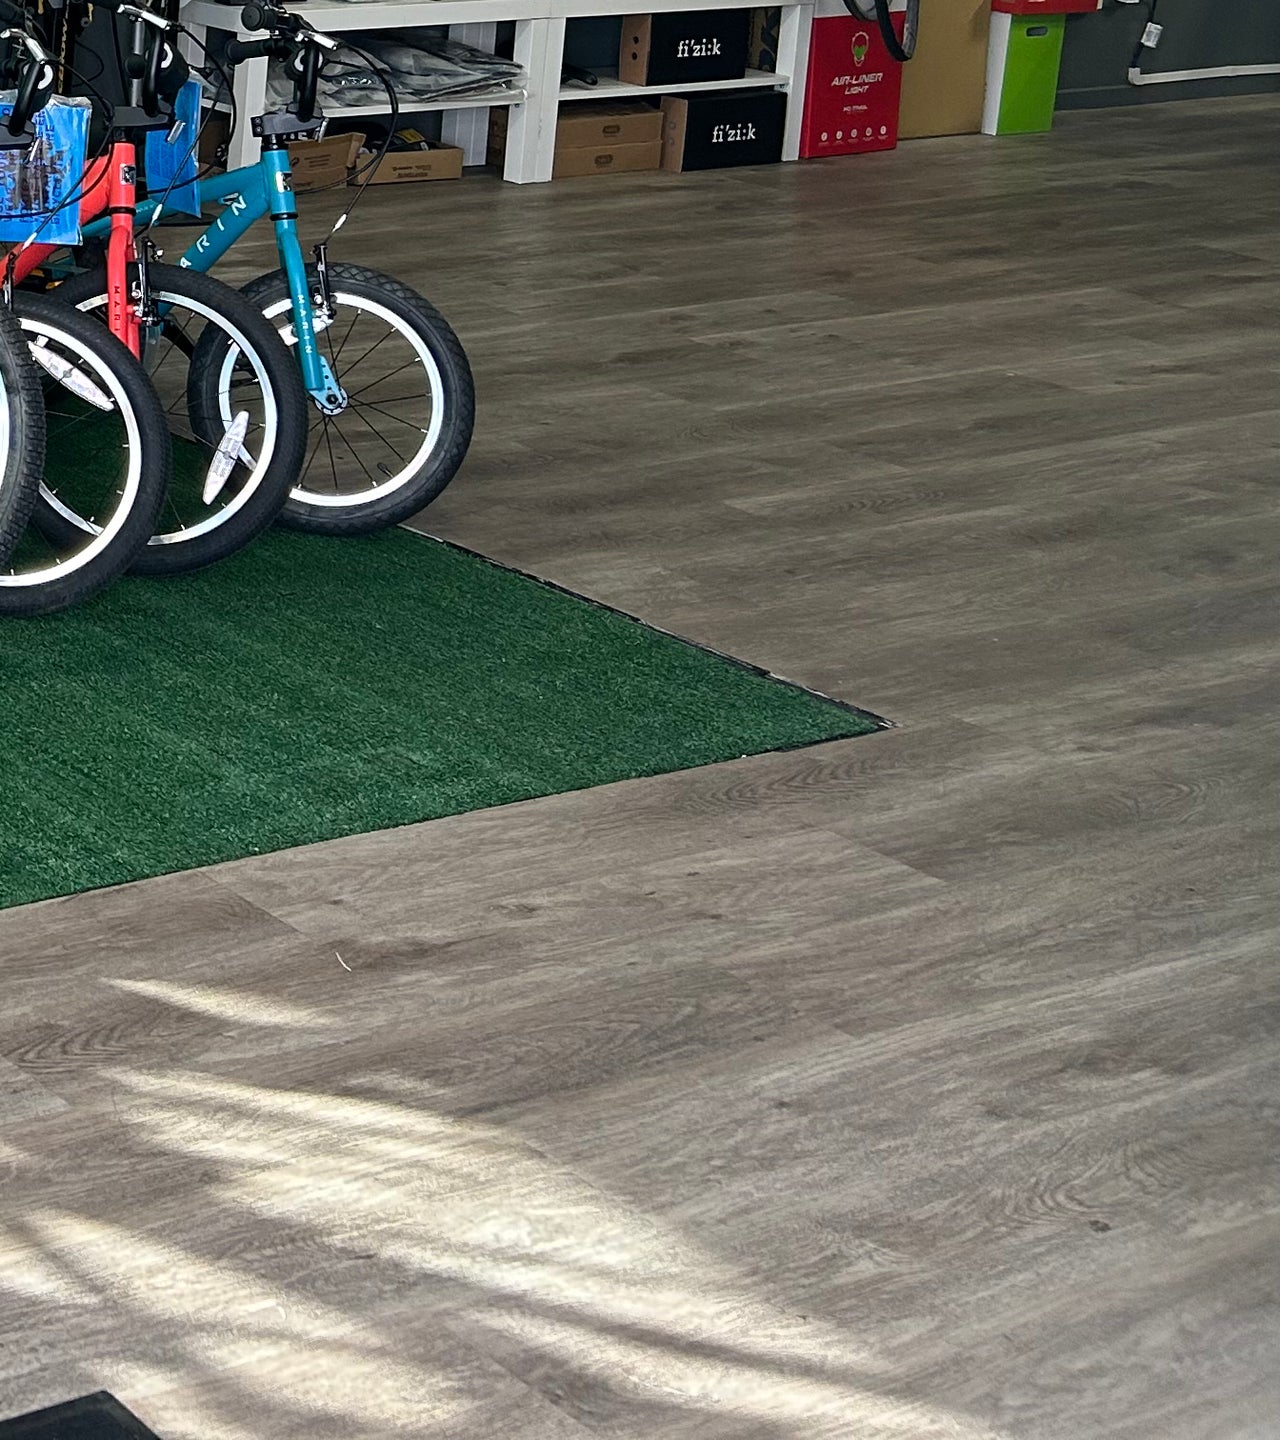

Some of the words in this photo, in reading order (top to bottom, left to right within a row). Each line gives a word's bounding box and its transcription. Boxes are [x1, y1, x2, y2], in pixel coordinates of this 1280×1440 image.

[831, 72, 884, 87] AIR-LINER
[844, 85, 870, 95] LIGHT
[178, 194, 247, 271] ARIN
[113, 285, 121, 332] MARI
[297, 294, 313, 355] MARIN
